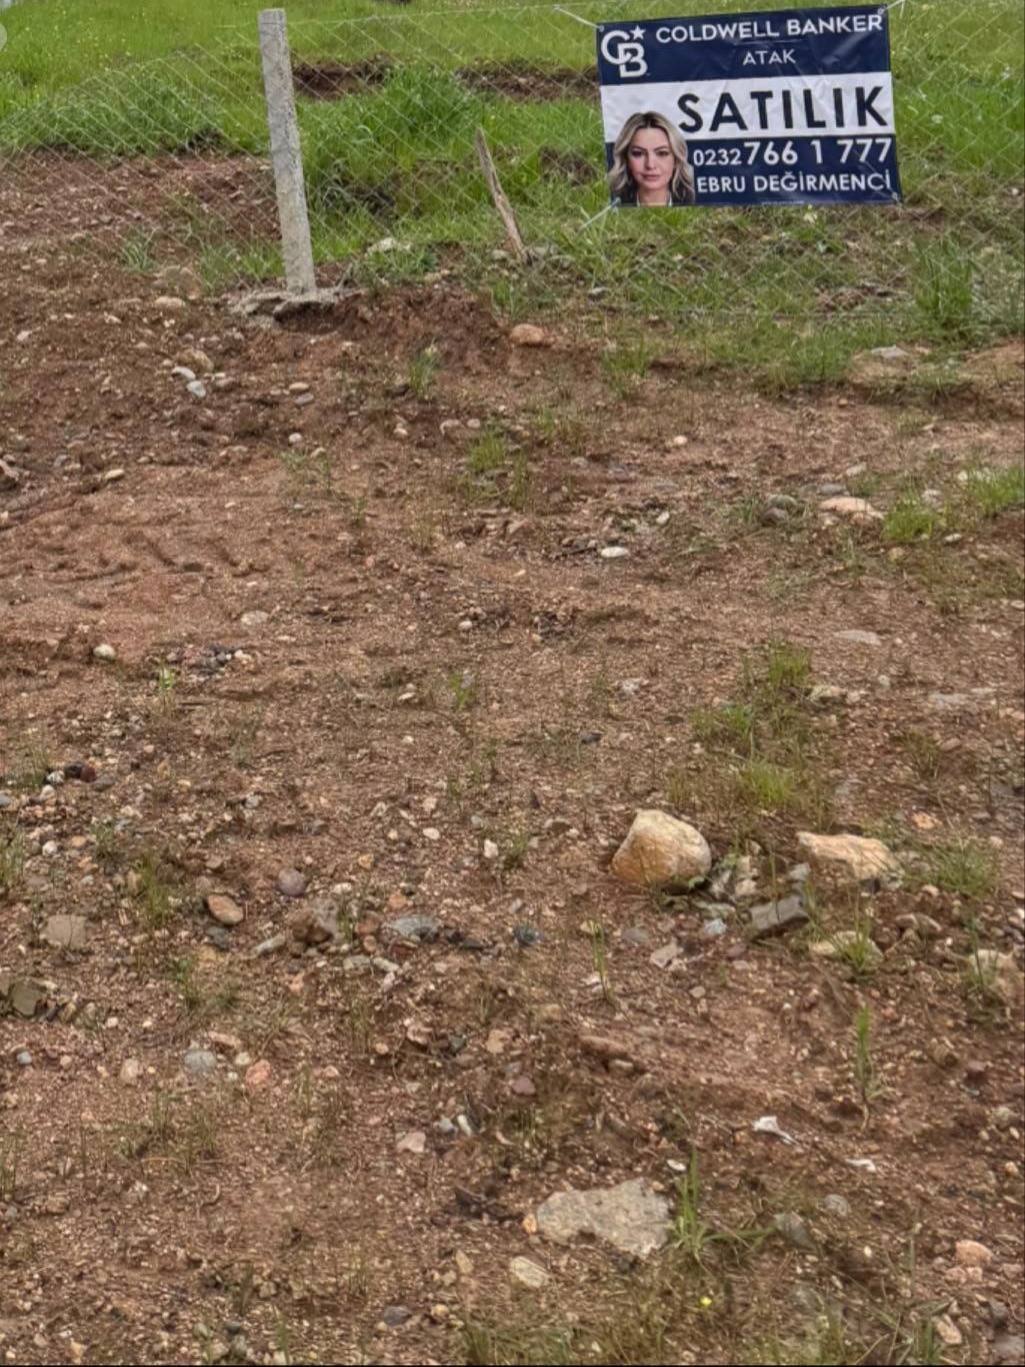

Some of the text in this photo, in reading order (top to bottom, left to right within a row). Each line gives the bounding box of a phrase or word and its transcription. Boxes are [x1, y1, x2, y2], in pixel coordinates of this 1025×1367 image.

[656, 15, 883, 43] COLDWELL BANKER
[743, 49, 796, 66] ATAK
[677, 86, 887, 133] SATILIK
[837, 139, 892, 163] 777
[697, 169, 891, 193] EBRU DEĞİRMENCİ
